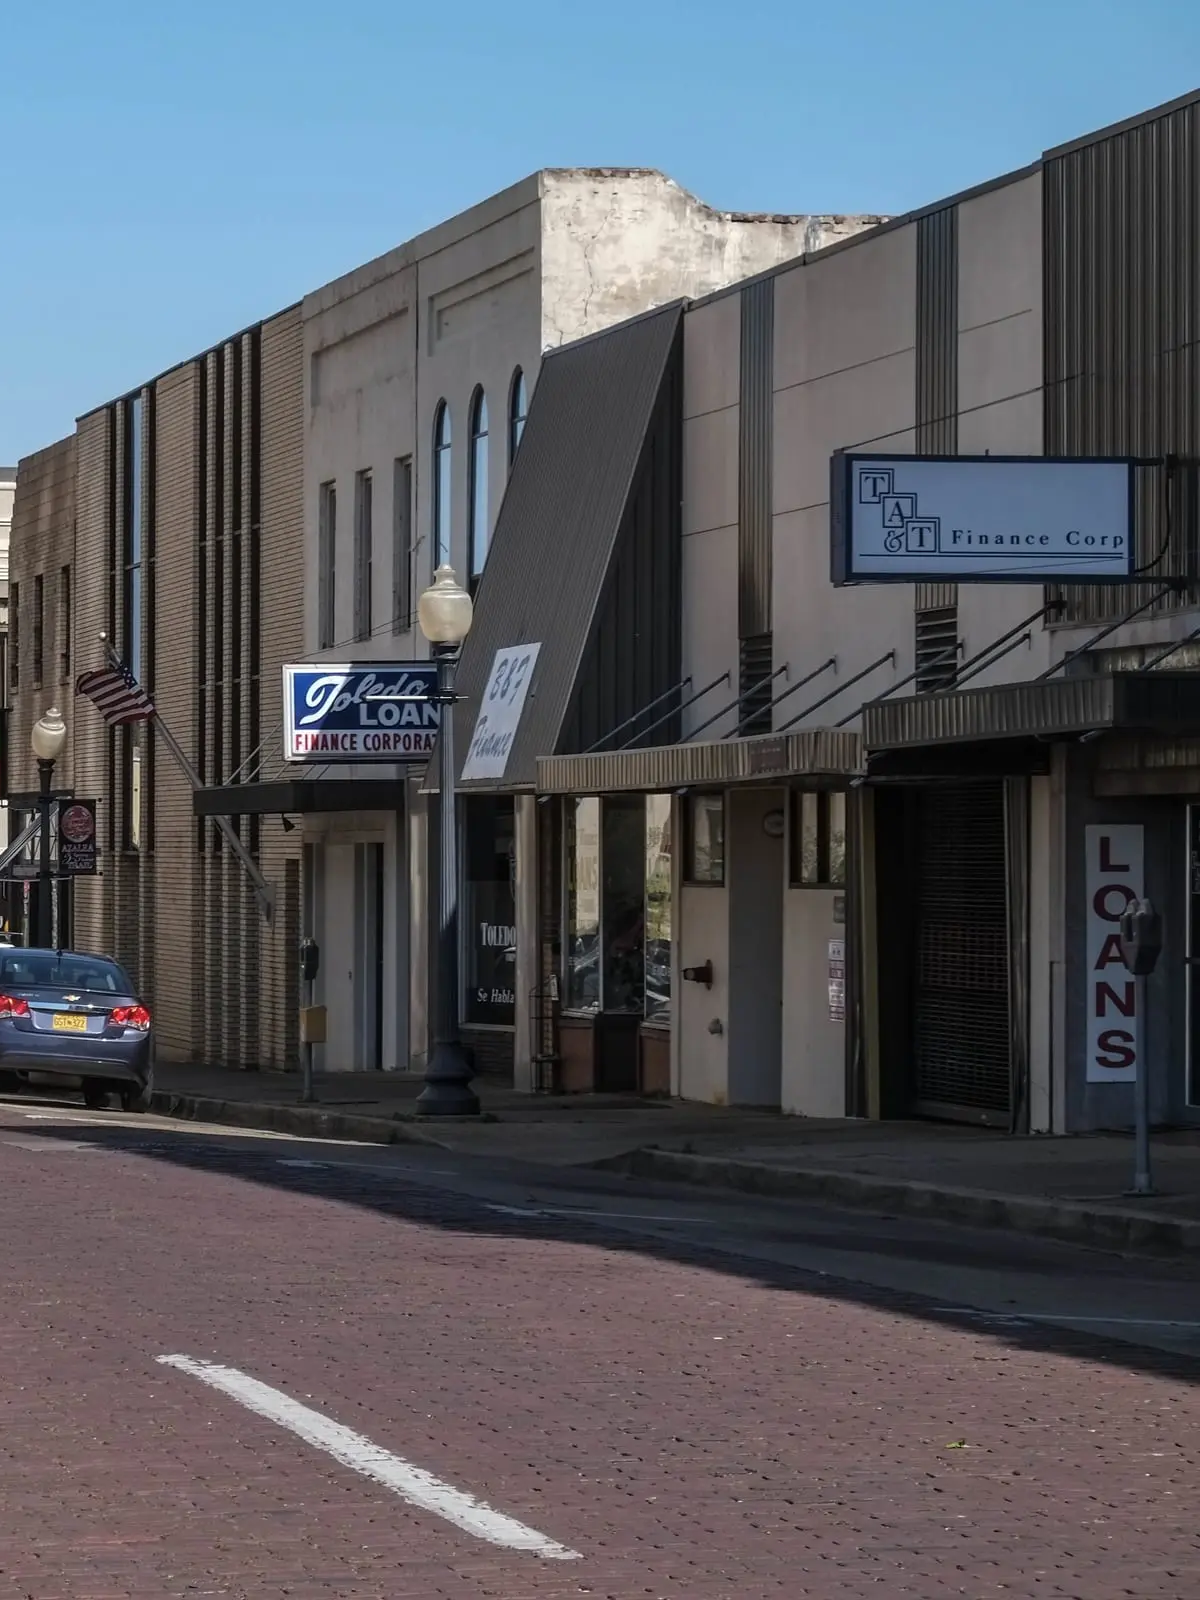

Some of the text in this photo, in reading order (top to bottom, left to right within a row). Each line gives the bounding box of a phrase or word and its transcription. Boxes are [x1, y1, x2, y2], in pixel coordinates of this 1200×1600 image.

[952, 529, 1050, 546] Finance
[1065, 530, 1125, 549] Corp
[299, 673, 429, 725] Toledo
[295, 733, 357, 752] FINANCE
[481, 922, 517, 947] TOLEDO
[1093, 836, 1138, 1069] LOANS
[477, 988, 515, 1004] Se Habla
